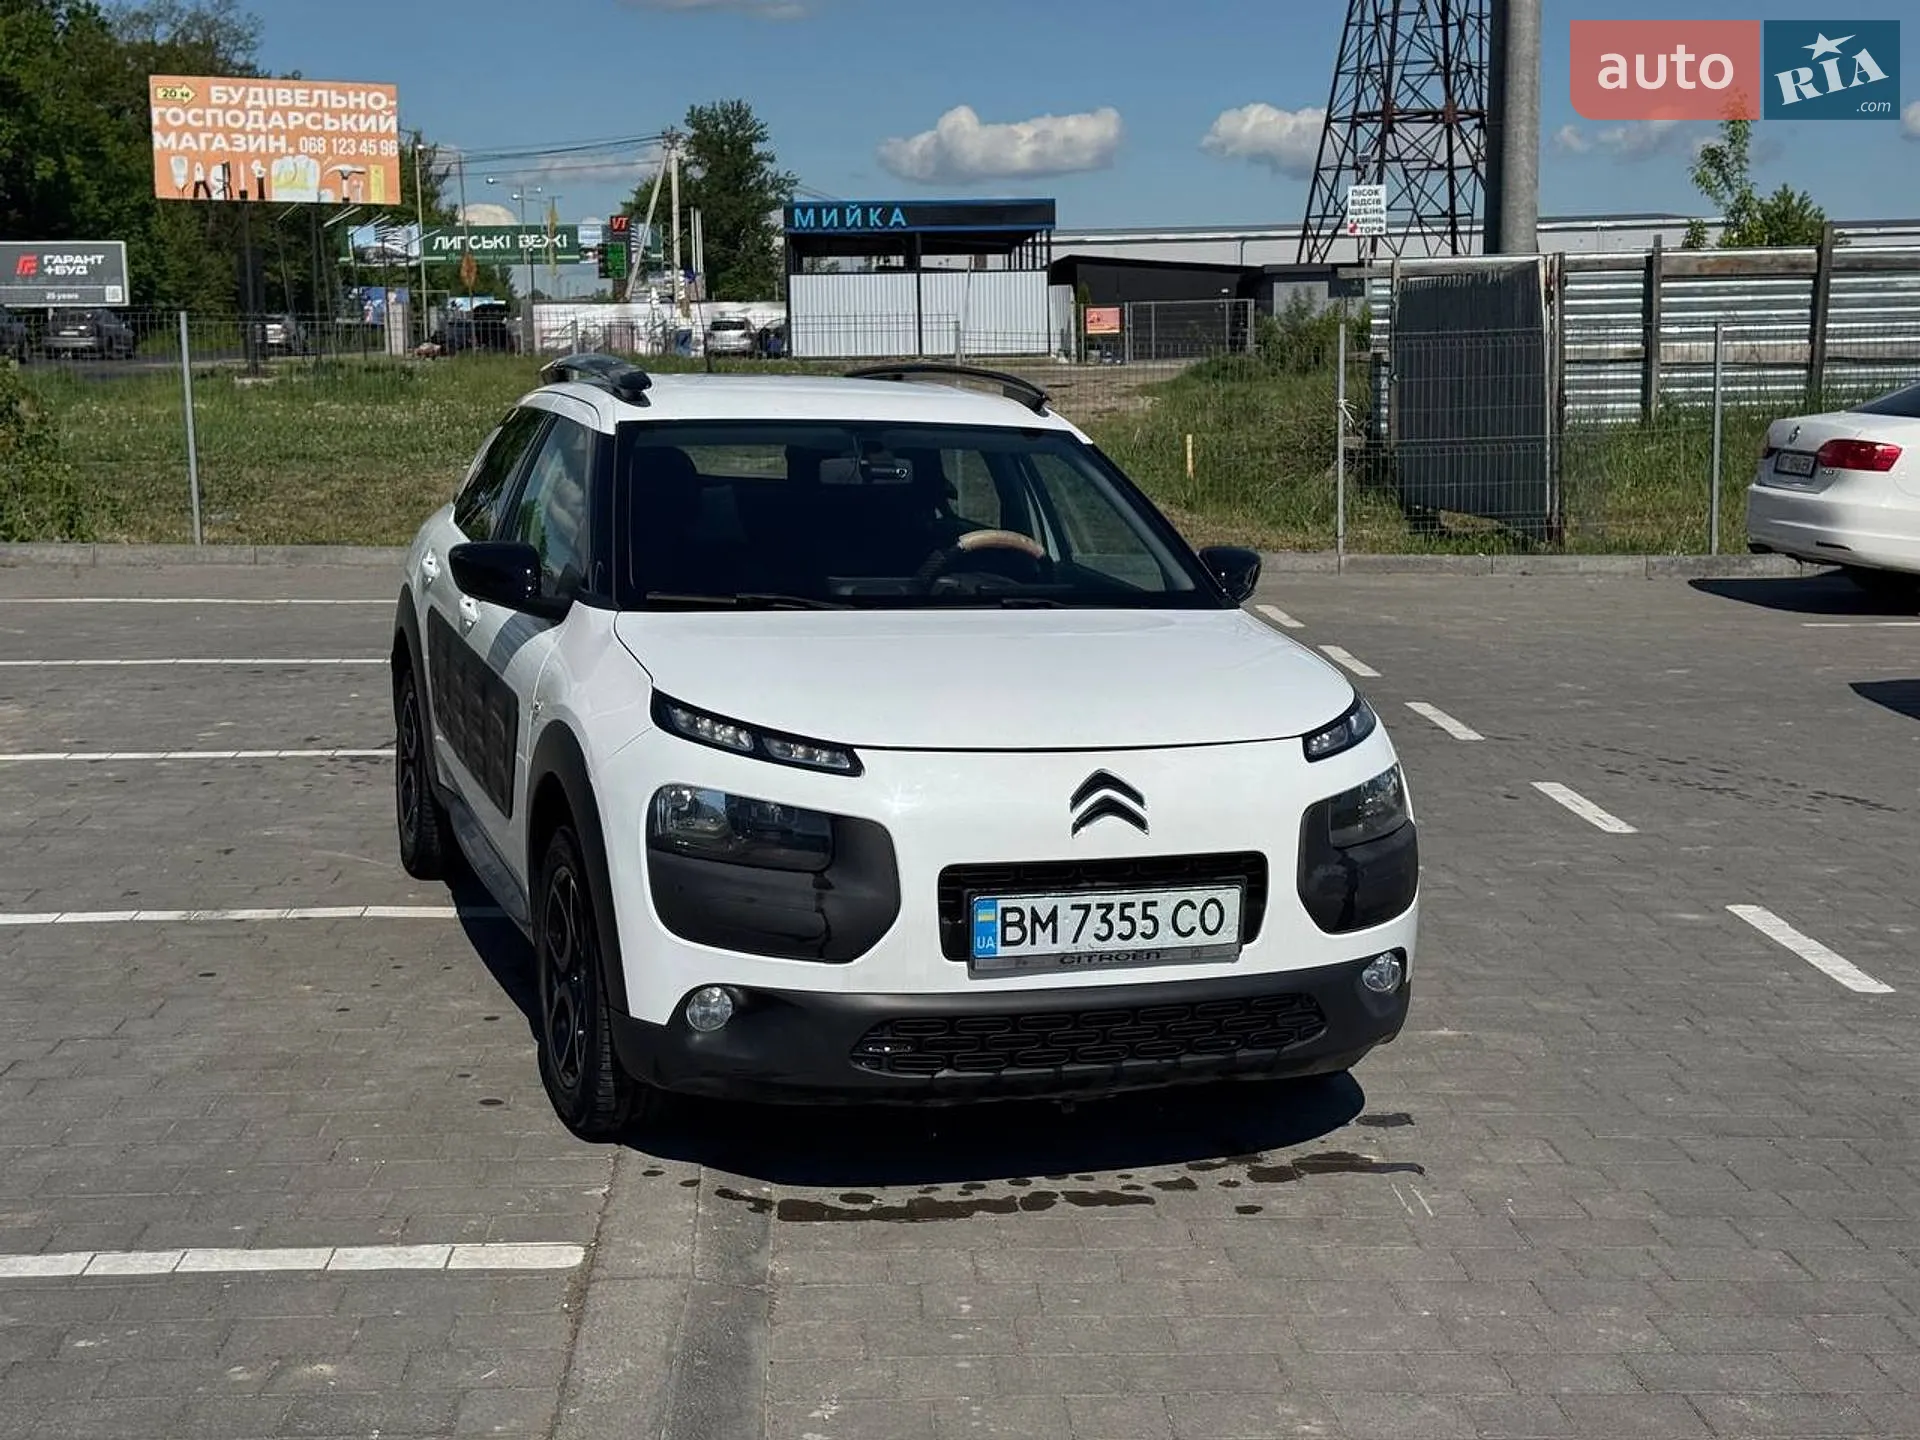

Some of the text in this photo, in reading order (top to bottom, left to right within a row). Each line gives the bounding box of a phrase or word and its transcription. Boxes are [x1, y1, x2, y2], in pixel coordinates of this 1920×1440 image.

[161, 88, 177, 98] 20
[210, 84, 397, 111] БУДІВЕЛЬНО-
[152, 106, 397, 134] ГОСПОДАРСЬКИЙ
[153, 131, 294, 153] МАГАЗИН.
[331, 136, 356, 156] 123
[360, 138, 377, 157] 45
[793, 204, 907, 228] МИЙКА
[43, 254, 105, 265] ГАРАНТ
[1001, 898, 1225, 947] BM 7355 CO
[976, 937, 995, 950] UA
